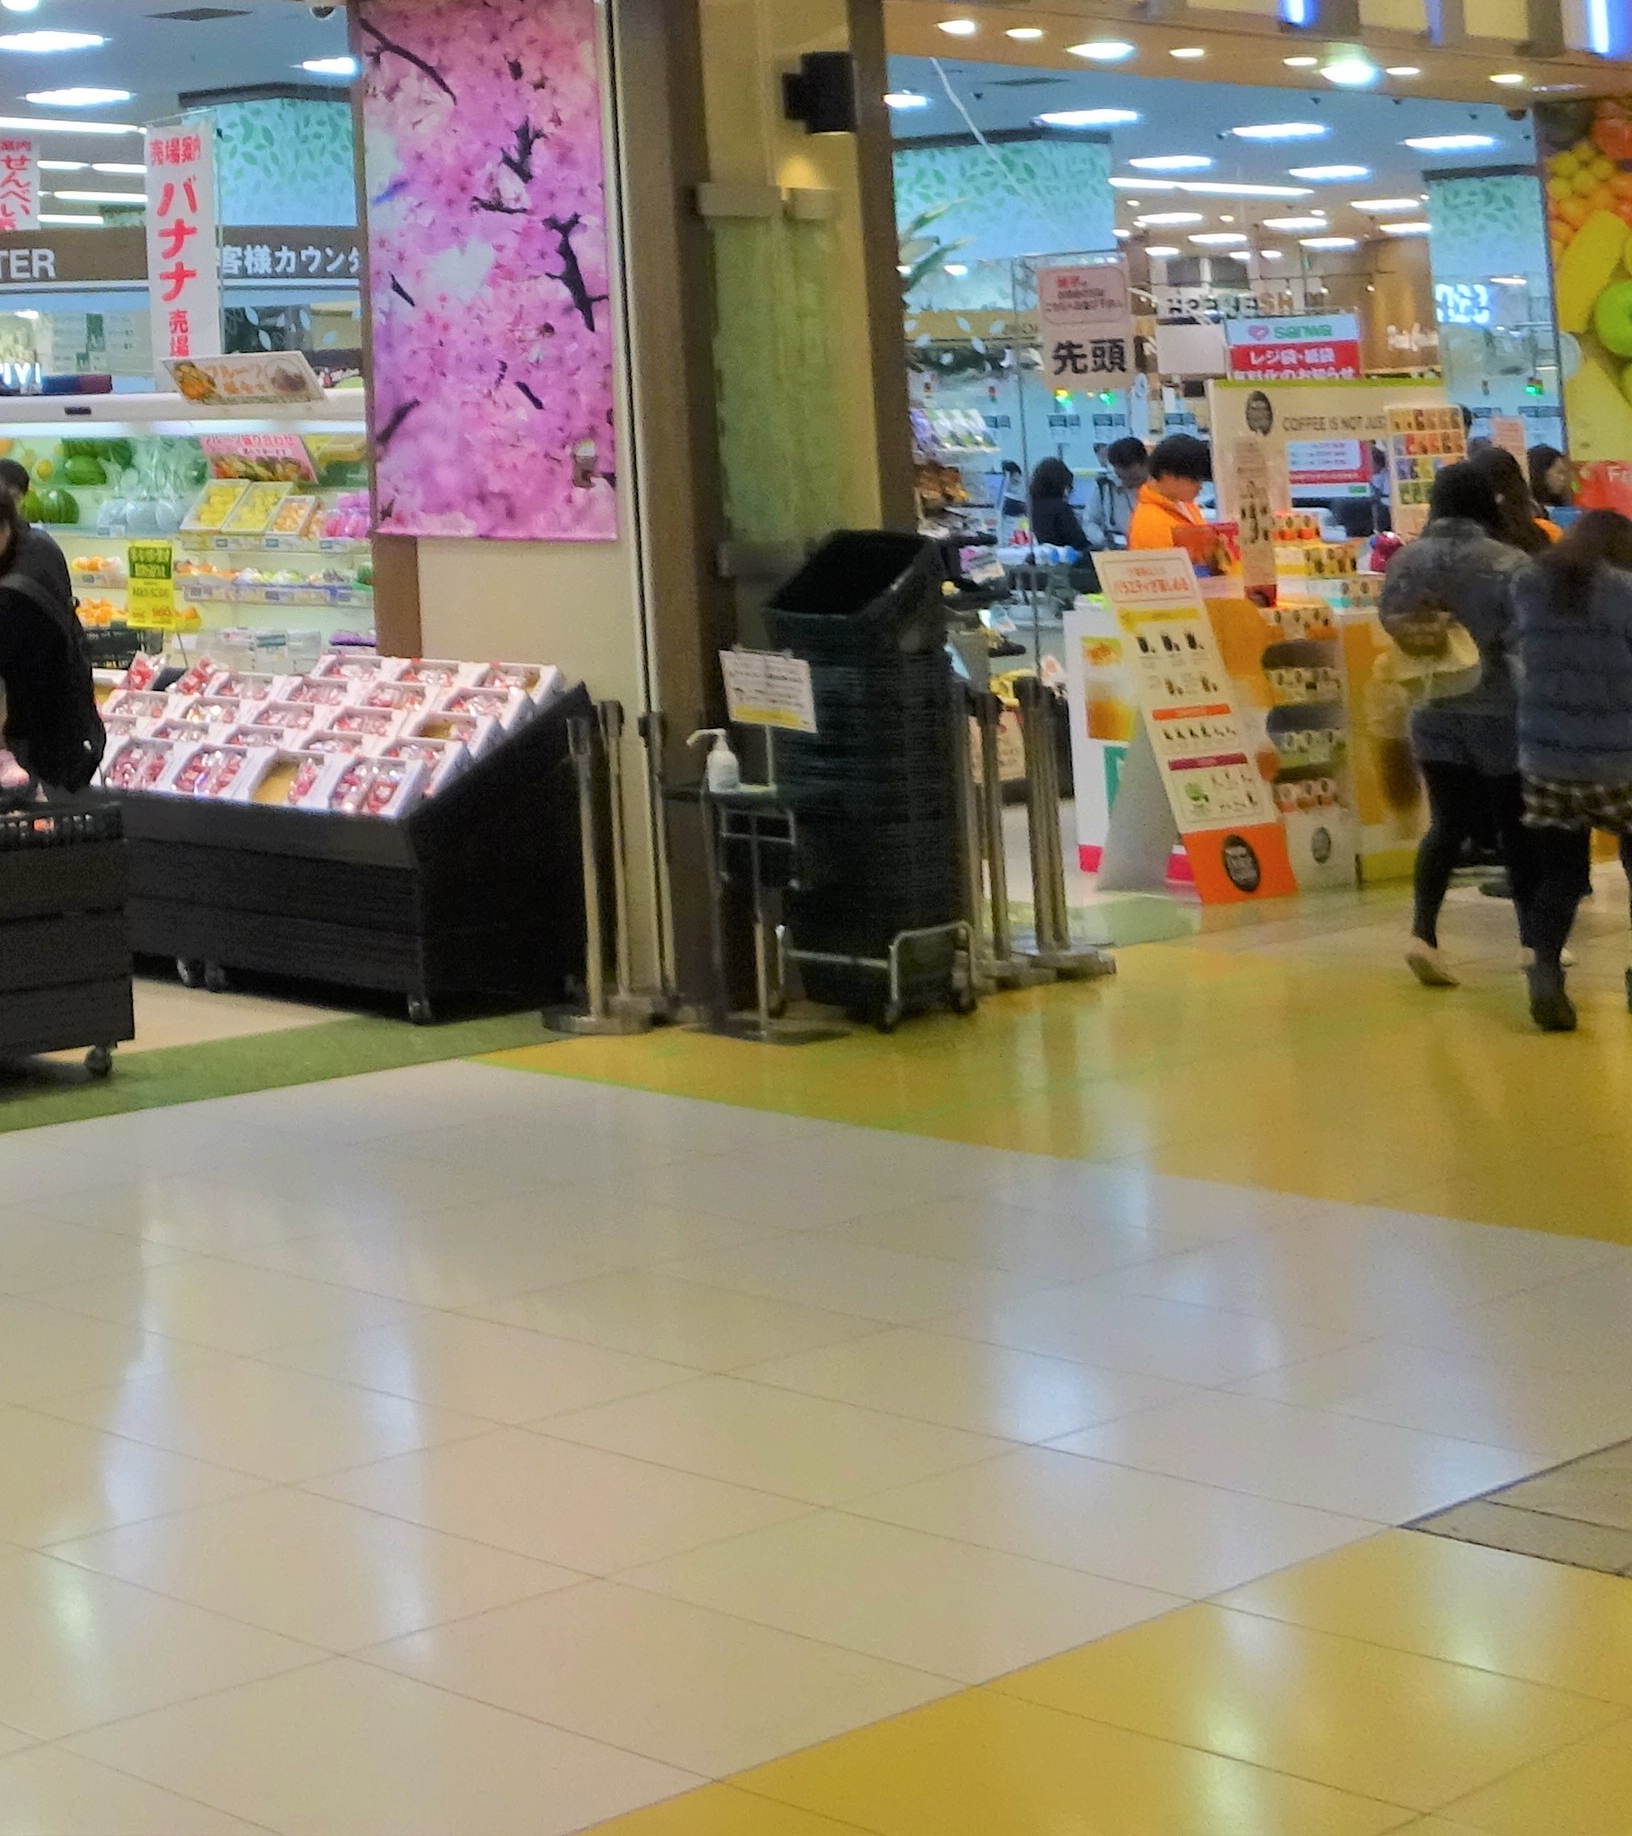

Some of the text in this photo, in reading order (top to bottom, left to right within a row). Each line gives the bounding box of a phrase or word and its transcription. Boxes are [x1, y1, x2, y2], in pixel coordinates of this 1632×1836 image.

[0, 153, 32, 218] せんべい
[156, 174, 198, 358] バナナ 売場
[1274, 323, 1334, 340] sanwa
[1051, 338, 1127, 376] 先頭
[1282, 416, 1327, 432] COFFEE
